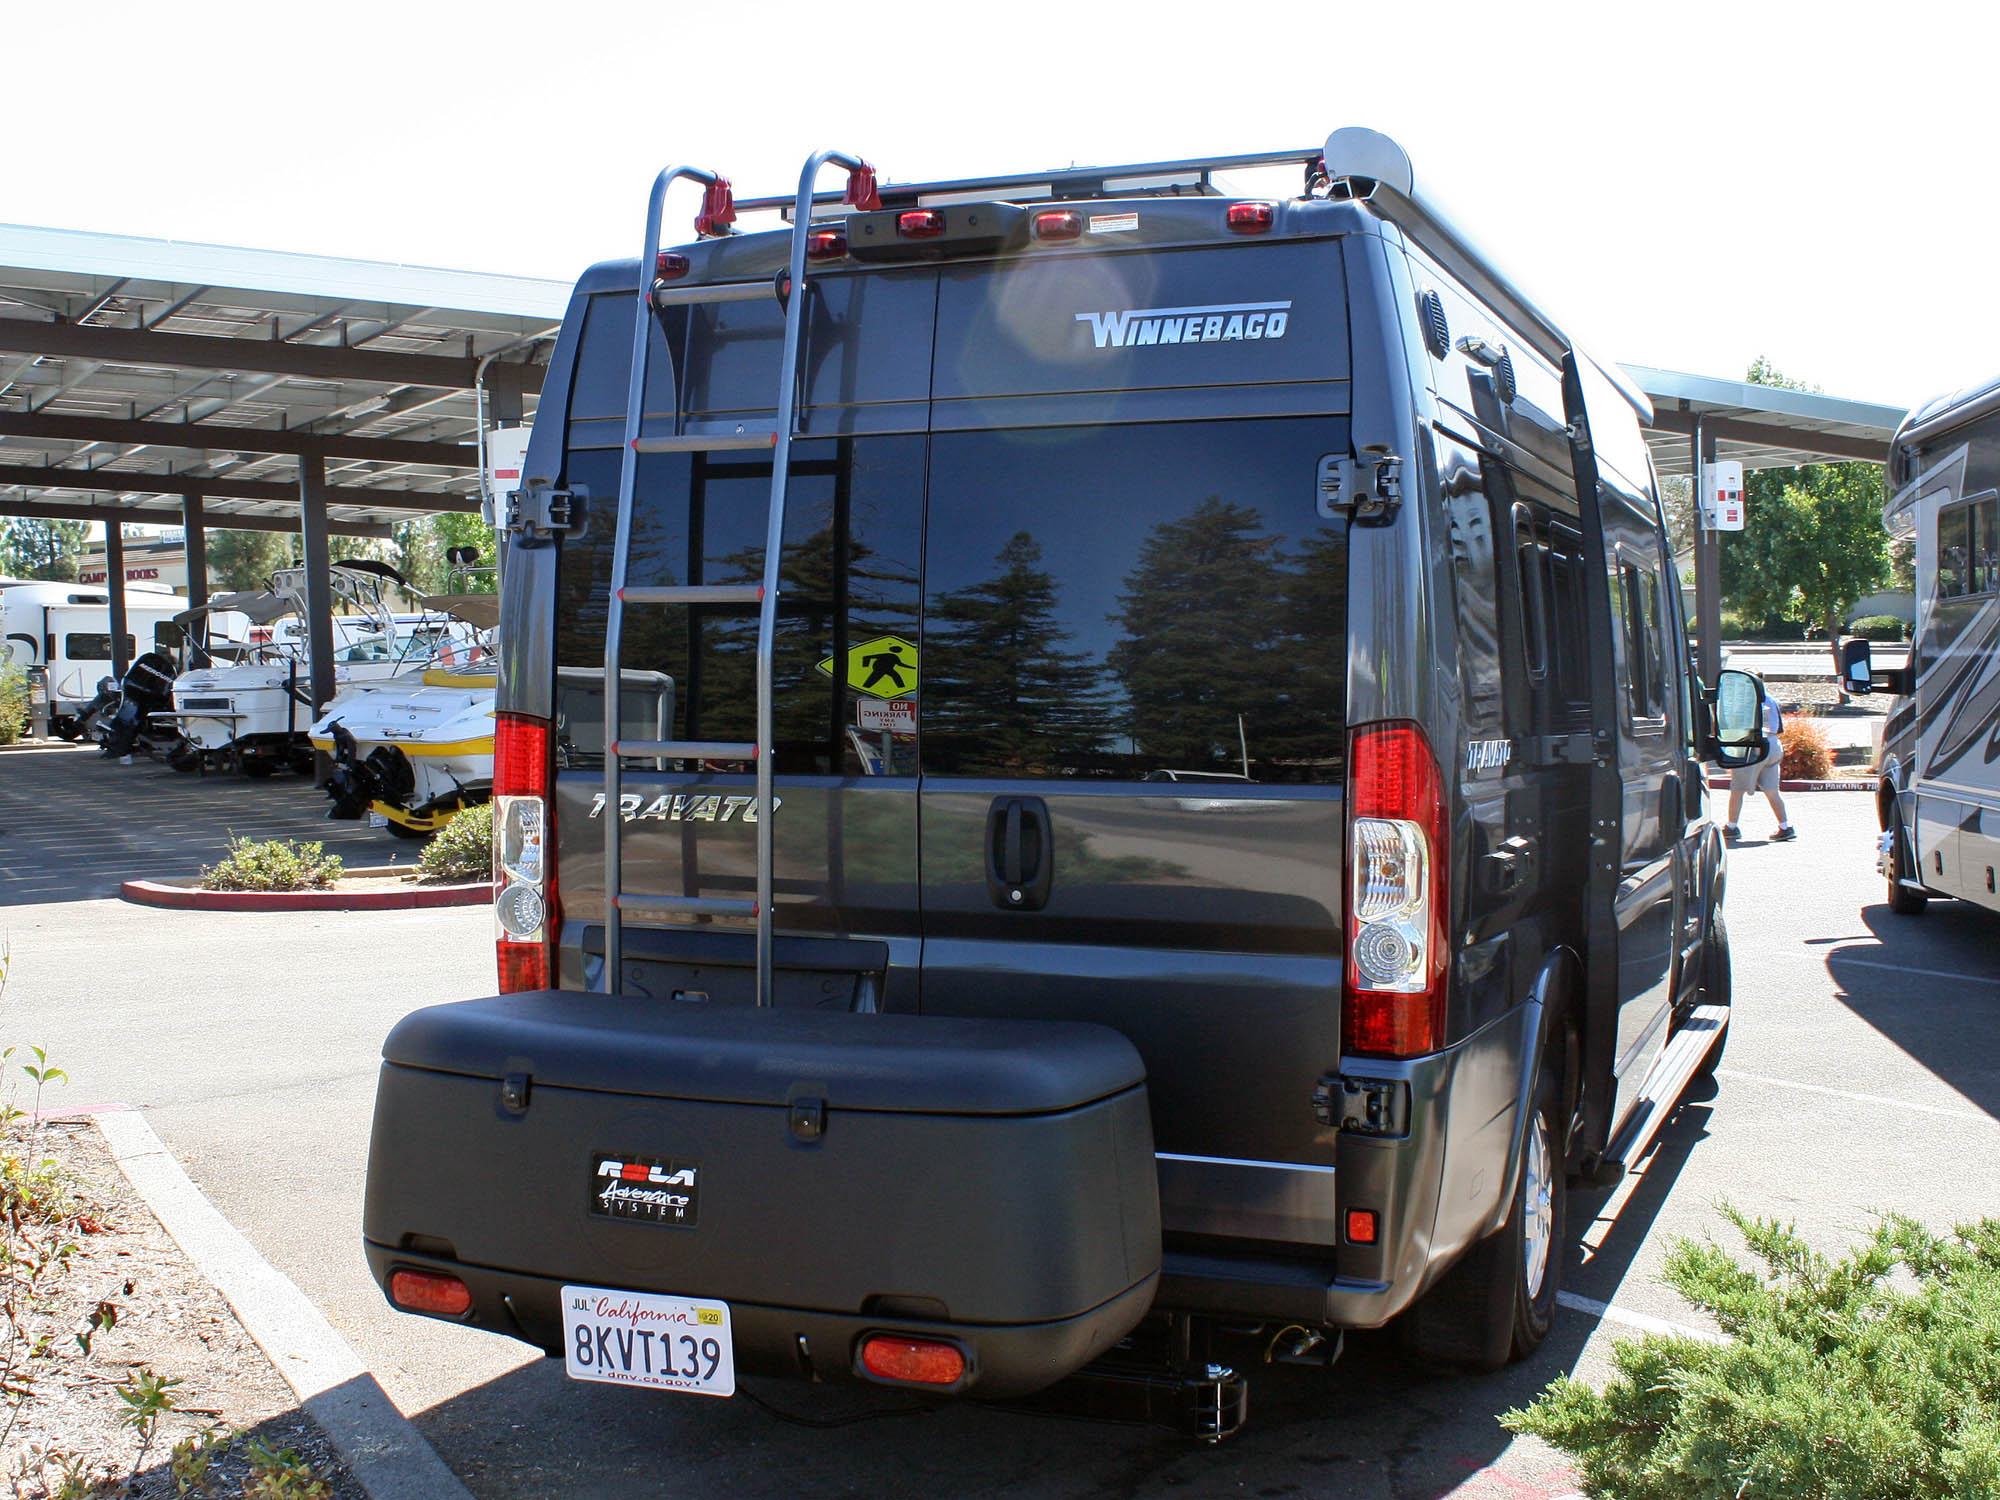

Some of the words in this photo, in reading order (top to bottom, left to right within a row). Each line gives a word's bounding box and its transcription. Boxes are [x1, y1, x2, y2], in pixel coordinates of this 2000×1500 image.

[1075, 300, 1293, 347] WINNEBAGO
[80, 572, 107, 584] CAMP
[126, 568, 159, 580] BOOKS
[588, 793, 784, 823] TRAVATO
[597, 1160, 696, 1187] ROLA
[599, 1179, 690, 1206] Adventure
[603, 1199, 684, 1218] SYSTEM
[572, 1298, 591, 1312] JUL
[596, 1297, 699, 1326] California
[708, 1313, 719, 1322] 20
[575, 1324, 721, 1381] 8KVT139
[608, 1372, 692, 1388] dmv.ca.gov
